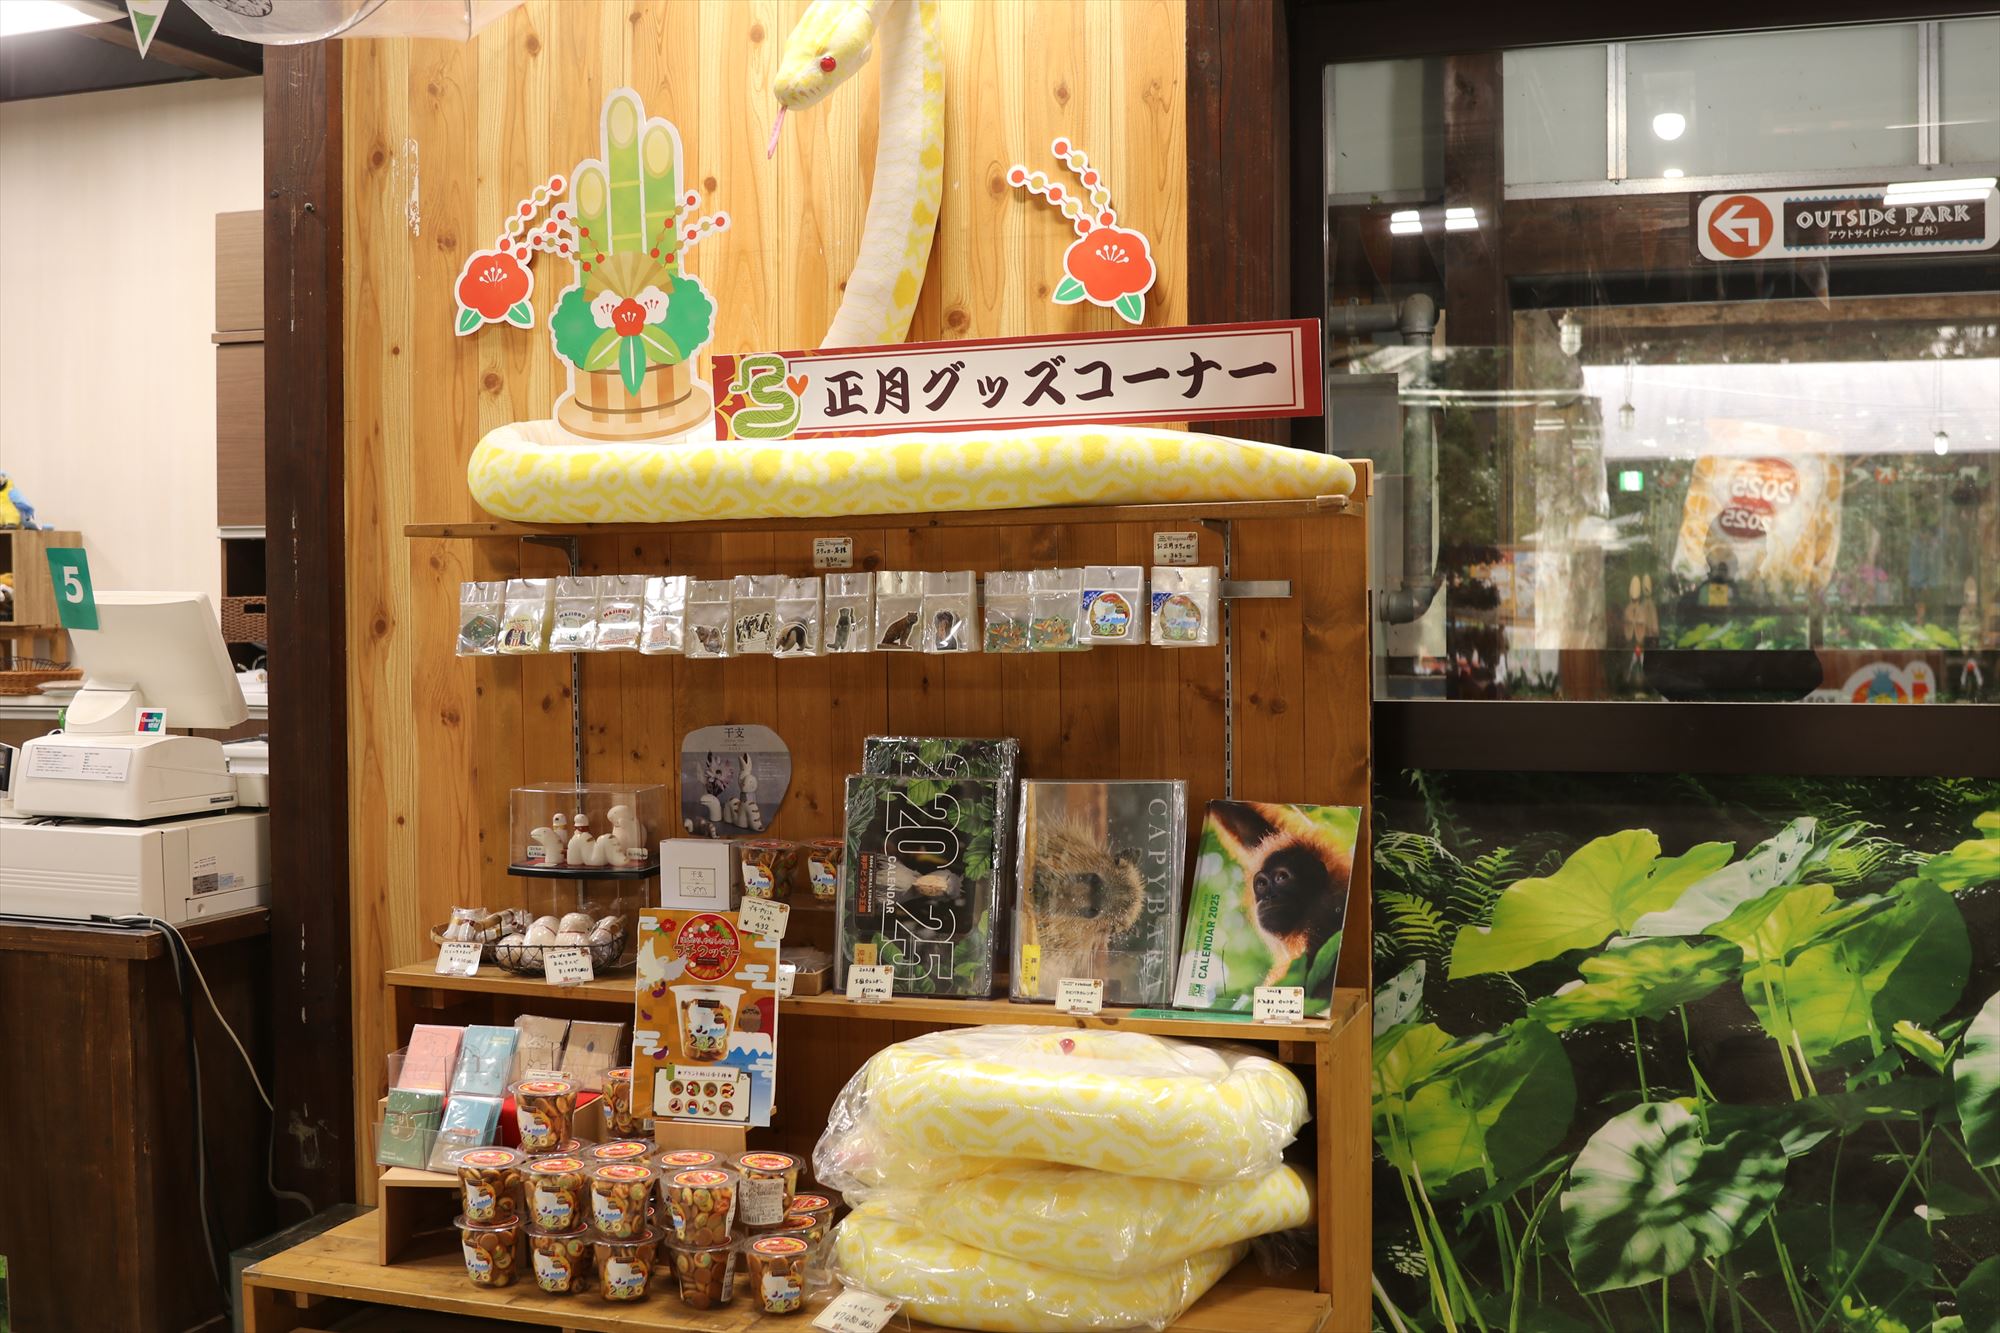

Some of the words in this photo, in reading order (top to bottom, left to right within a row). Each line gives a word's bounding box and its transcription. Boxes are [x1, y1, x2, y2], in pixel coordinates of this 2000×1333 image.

[1796, 207, 1896, 229] OUTSIDE
[1905, 204, 1971, 224] PARK
[823, 351, 1278, 418] 正月グッズコーナー
[62, 565, 85, 604] 5
[724, 727, 745, 739] 干支
[880, 792, 961, 980] 2025
[885, 855, 896, 914] CALENDAR
[755, 922, 769, 930] 432
[1197, 921, 1215, 980] CALENDAR
[1208, 893, 1221, 919] 2025
[673, 943, 741, 958] プチクッキー
